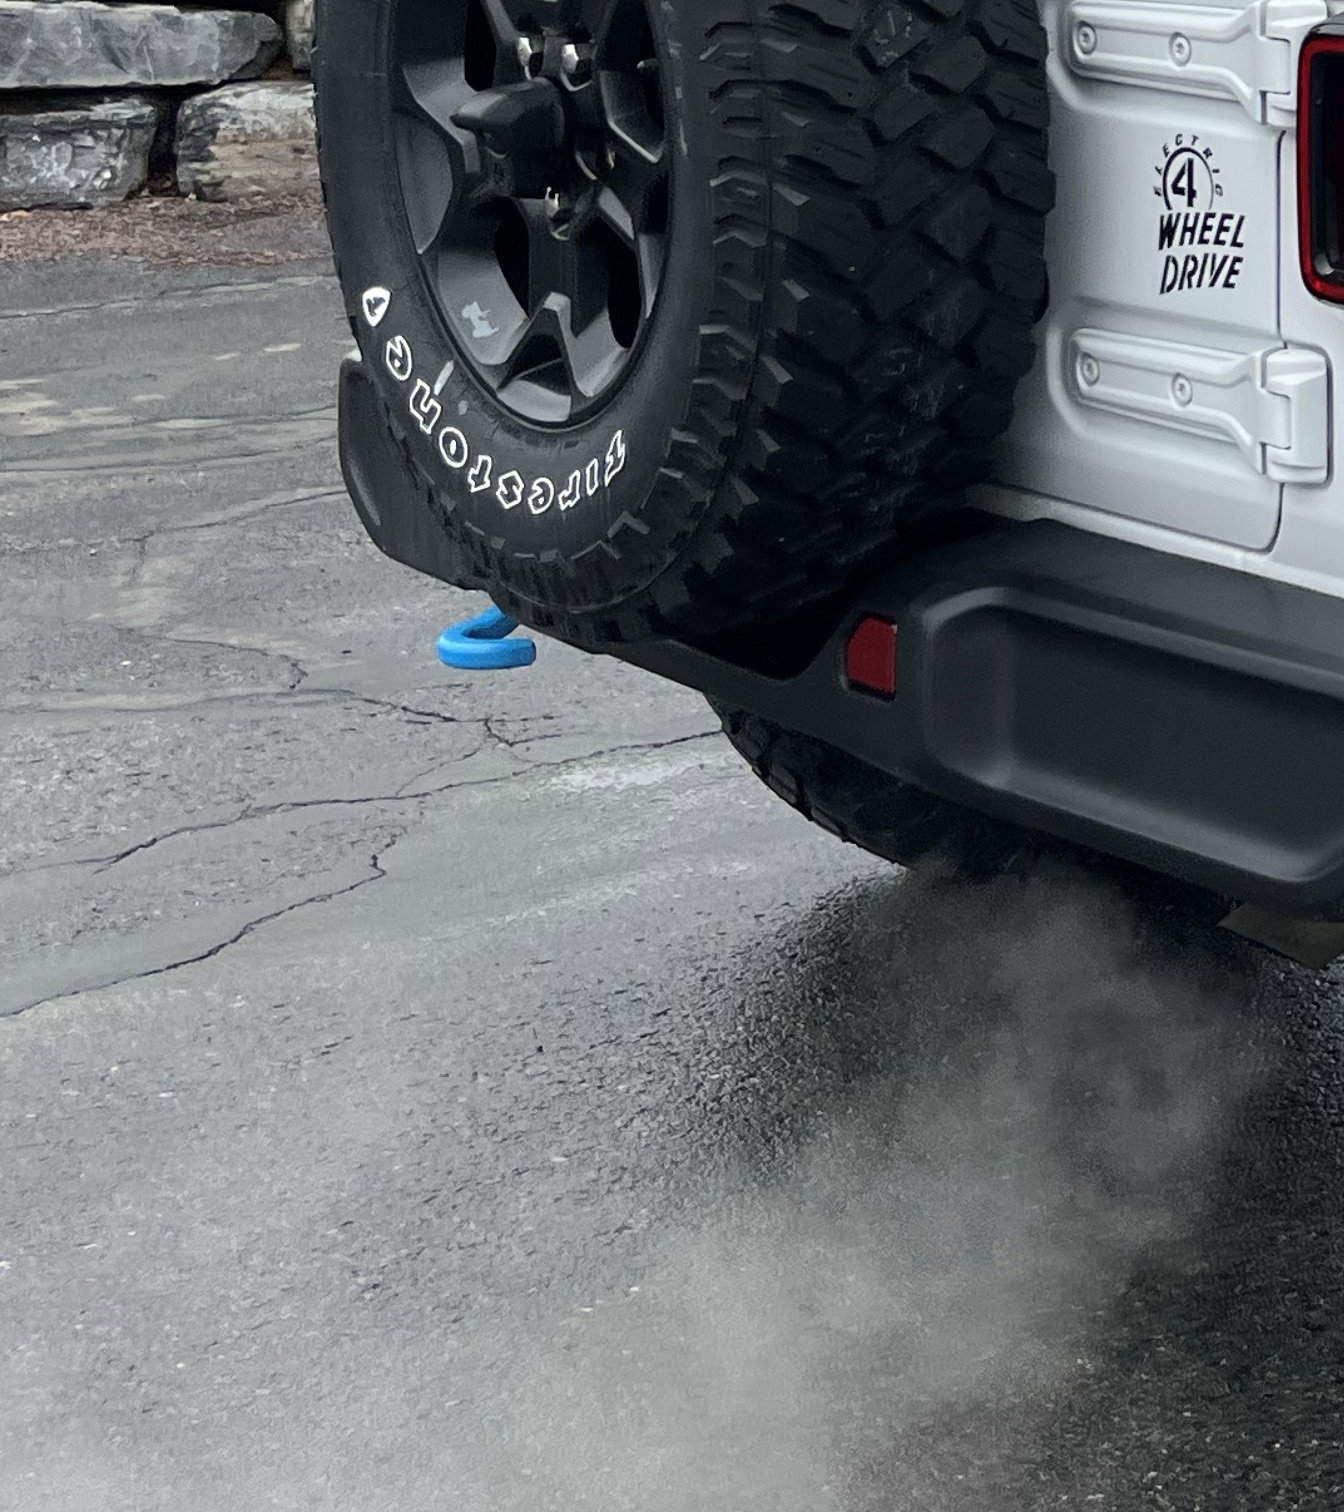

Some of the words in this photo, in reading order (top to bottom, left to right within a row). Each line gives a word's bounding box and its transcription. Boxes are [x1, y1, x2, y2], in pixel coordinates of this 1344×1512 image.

[1152, 133, 1224, 197] ELECTRIC
[1171, 157, 1198, 208] 4
[1157, 211, 1247, 251] WHEEL
[1159, 252, 1245, 296] DRIVE
